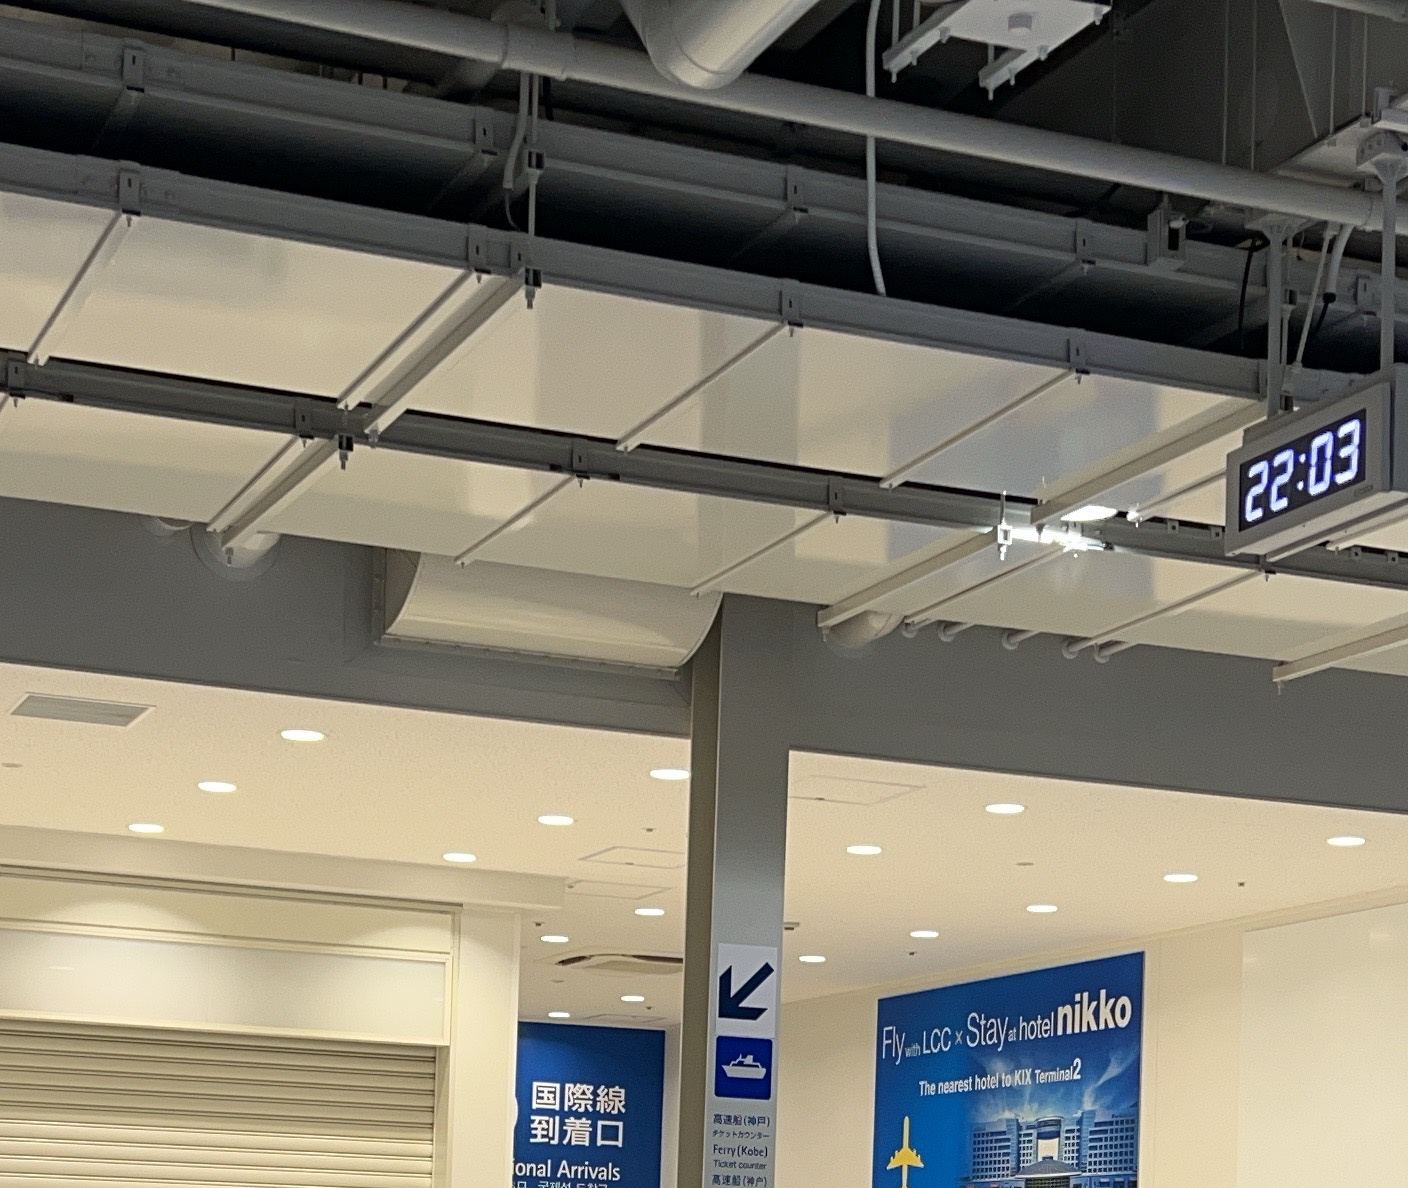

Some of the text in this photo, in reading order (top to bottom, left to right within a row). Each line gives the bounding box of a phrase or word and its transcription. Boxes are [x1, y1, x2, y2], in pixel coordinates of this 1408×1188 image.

[1244, 418, 1362, 523] 22:03
[882, 1025, 906, 1066] Fly
[905, 1042, 921, 1057] with
[922, 1026, 952, 1055] LCC
[966, 1012, 1009, 1052] Stay
[1007, 1027, 1017, 1042] at
[1019, 1011, 1054, 1041] hotel
[1056, 988, 1132, 1036] nikko
[531, 1081, 627, 1115] 国際線
[918, 1080, 936, 1097] The
[938, 1076, 973, 1095] nearest
[975, 1073, 999, 1091] hotel
[1001, 1072, 1012, 1088] to
[1014, 1068, 1032, 1086] KIX
[529, 1115, 624, 1148] 到着口
[556, 1159, 621, 1182] Arrivals
[713, 1159, 767, 1171] Ticket counter
